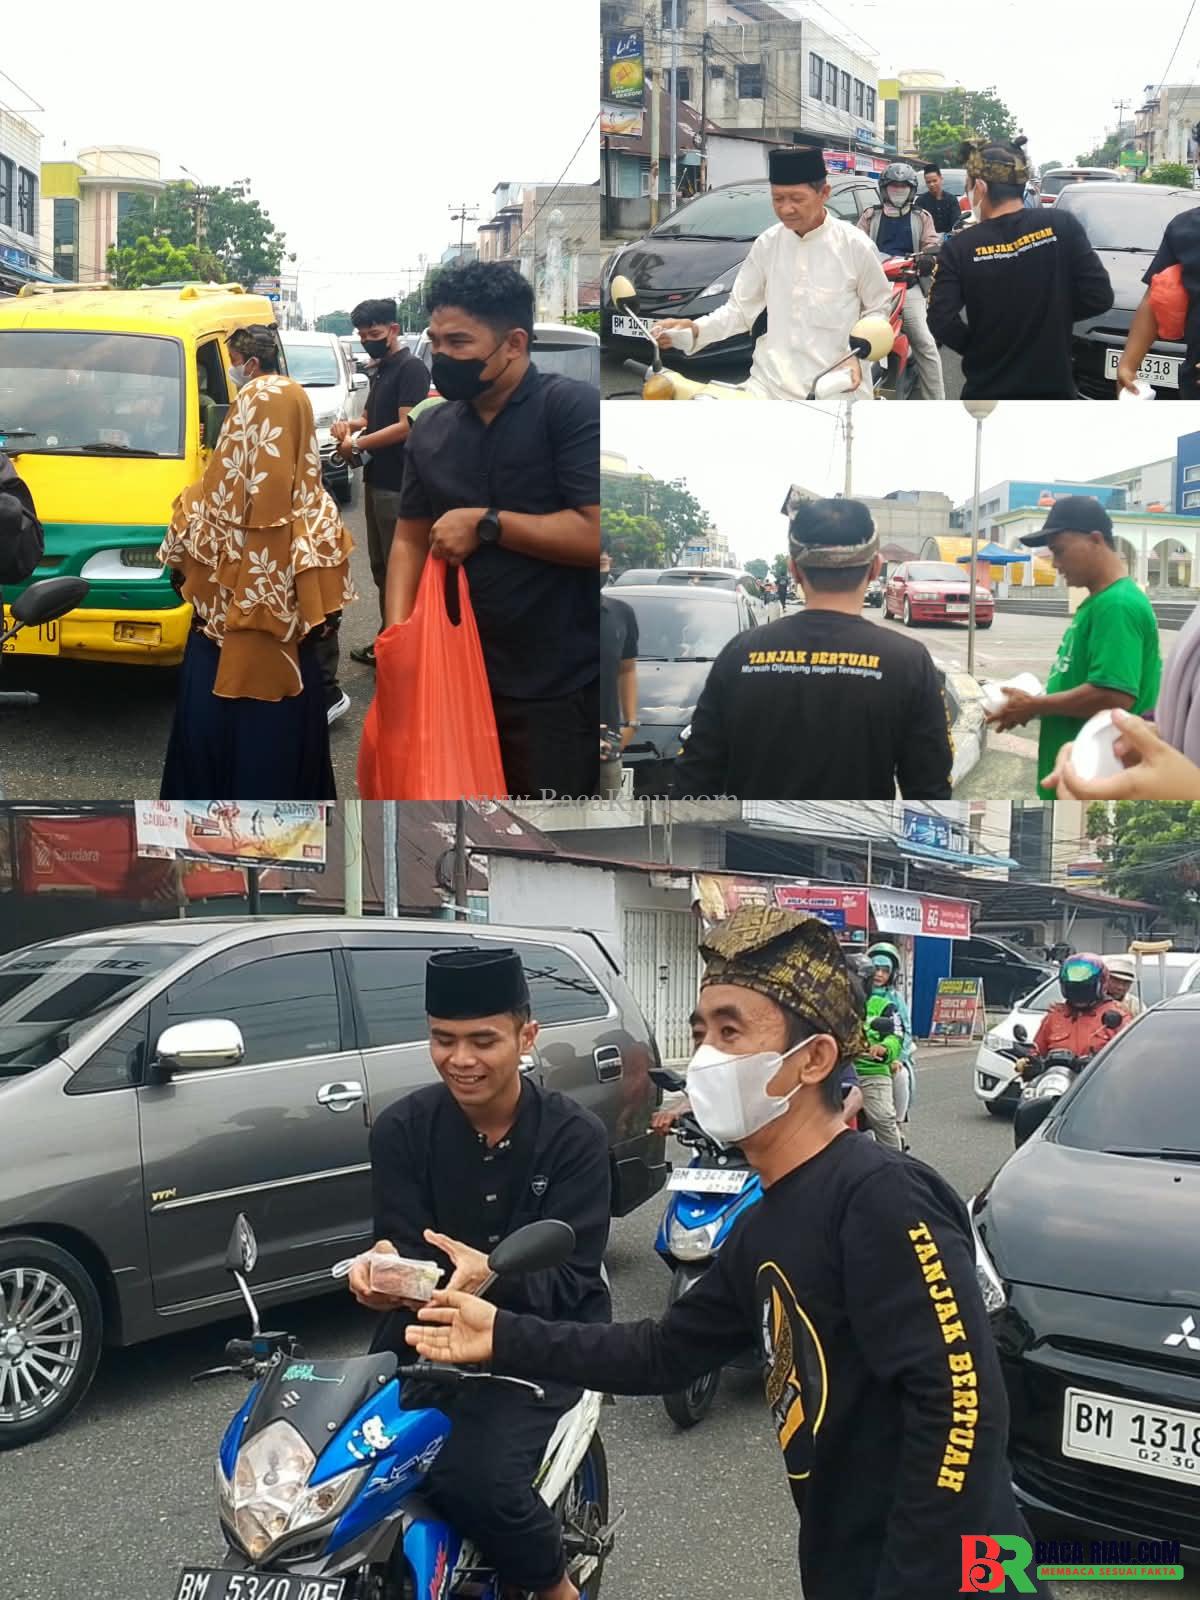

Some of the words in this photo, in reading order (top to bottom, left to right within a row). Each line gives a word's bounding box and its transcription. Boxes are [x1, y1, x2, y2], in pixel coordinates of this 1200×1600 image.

[975, 243, 1014, 256] TANJAK
[1137, 358, 1171, 375] 318
[748, 650, 807, 665] TANJAK
[809, 651, 881, 669] BERTUAH
[908, 1222, 966, 1344] TANJAK
[937, 1351, 978, 1493] BERTUAH
[1075, 1402, 1114, 1438] BM
[1130, 1413, 1200, 1458] 1318
[178, 1574, 211, 1600] BM
